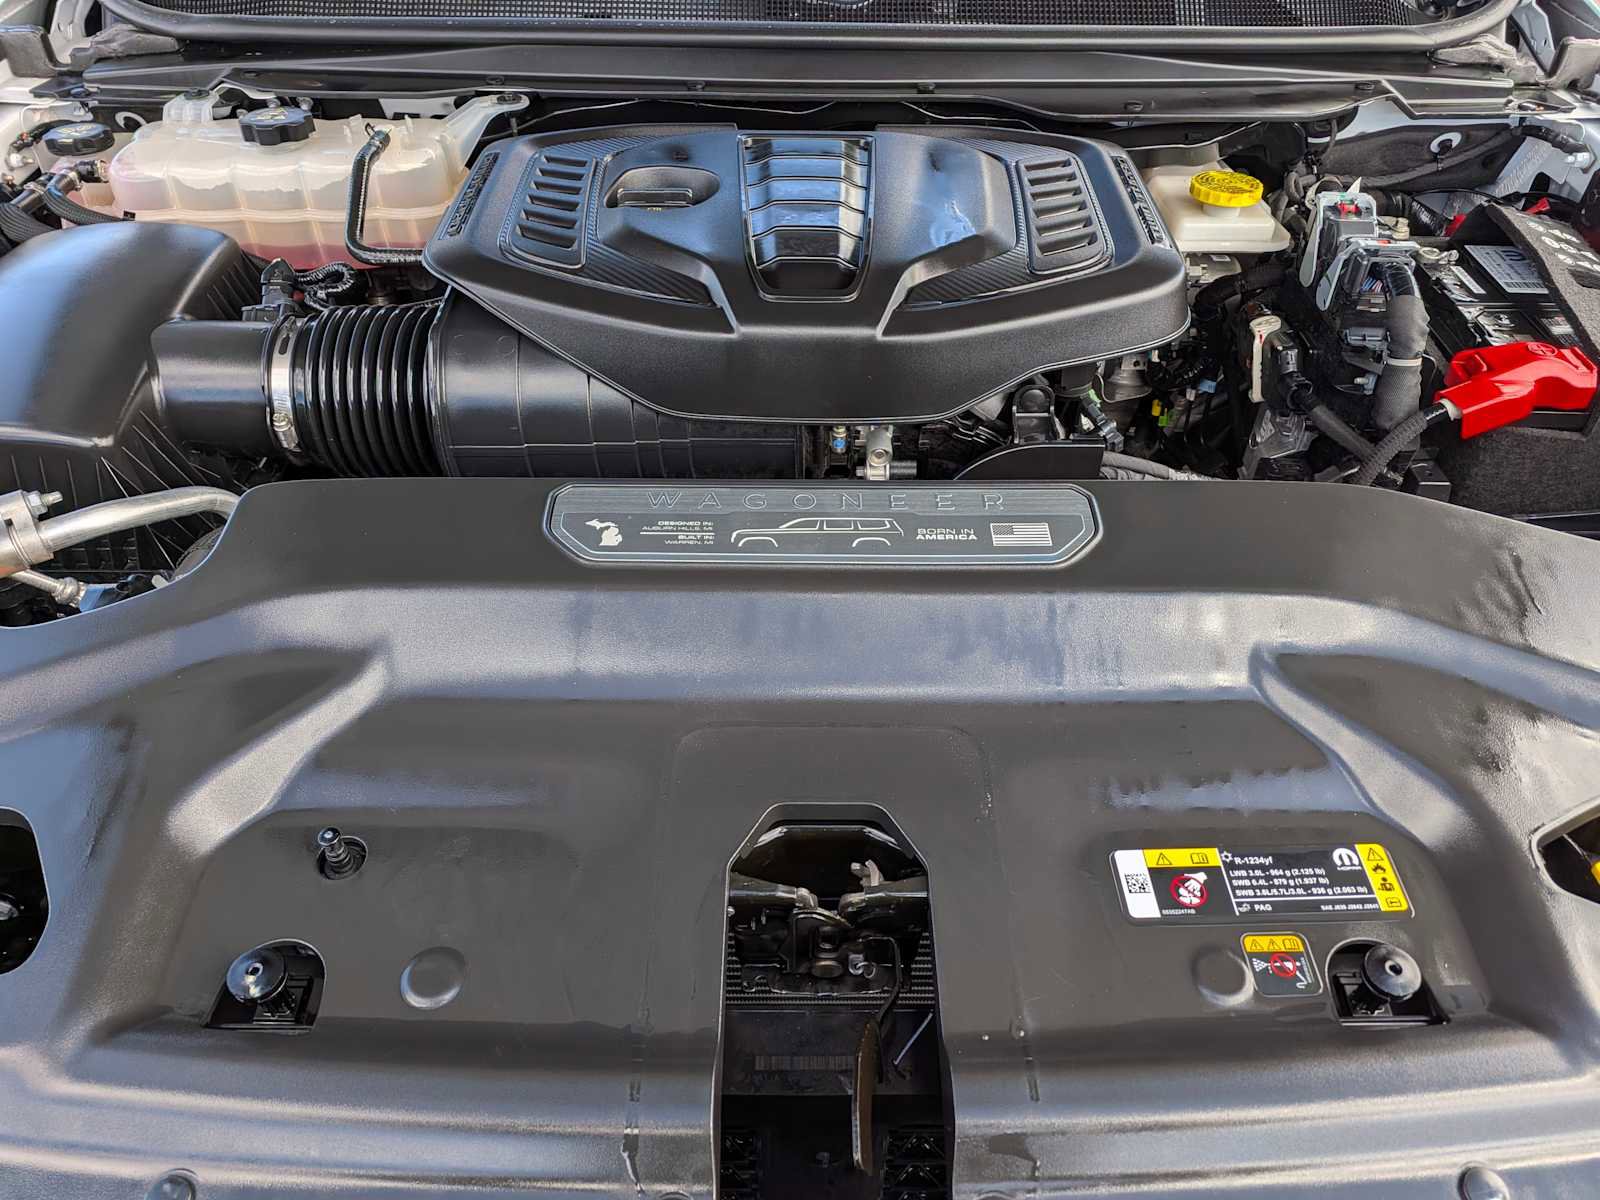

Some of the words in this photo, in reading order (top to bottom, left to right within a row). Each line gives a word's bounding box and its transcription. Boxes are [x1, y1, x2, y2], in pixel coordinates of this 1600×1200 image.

[647, 491, 1004, 511] WAGONEER
[1233, 855, 1273, 866] R-1234yf
[1229, 869, 1247, 877] LWB
[1231, 878, 1251, 887] SWB
[1235, 889, 1255, 897] SWB
